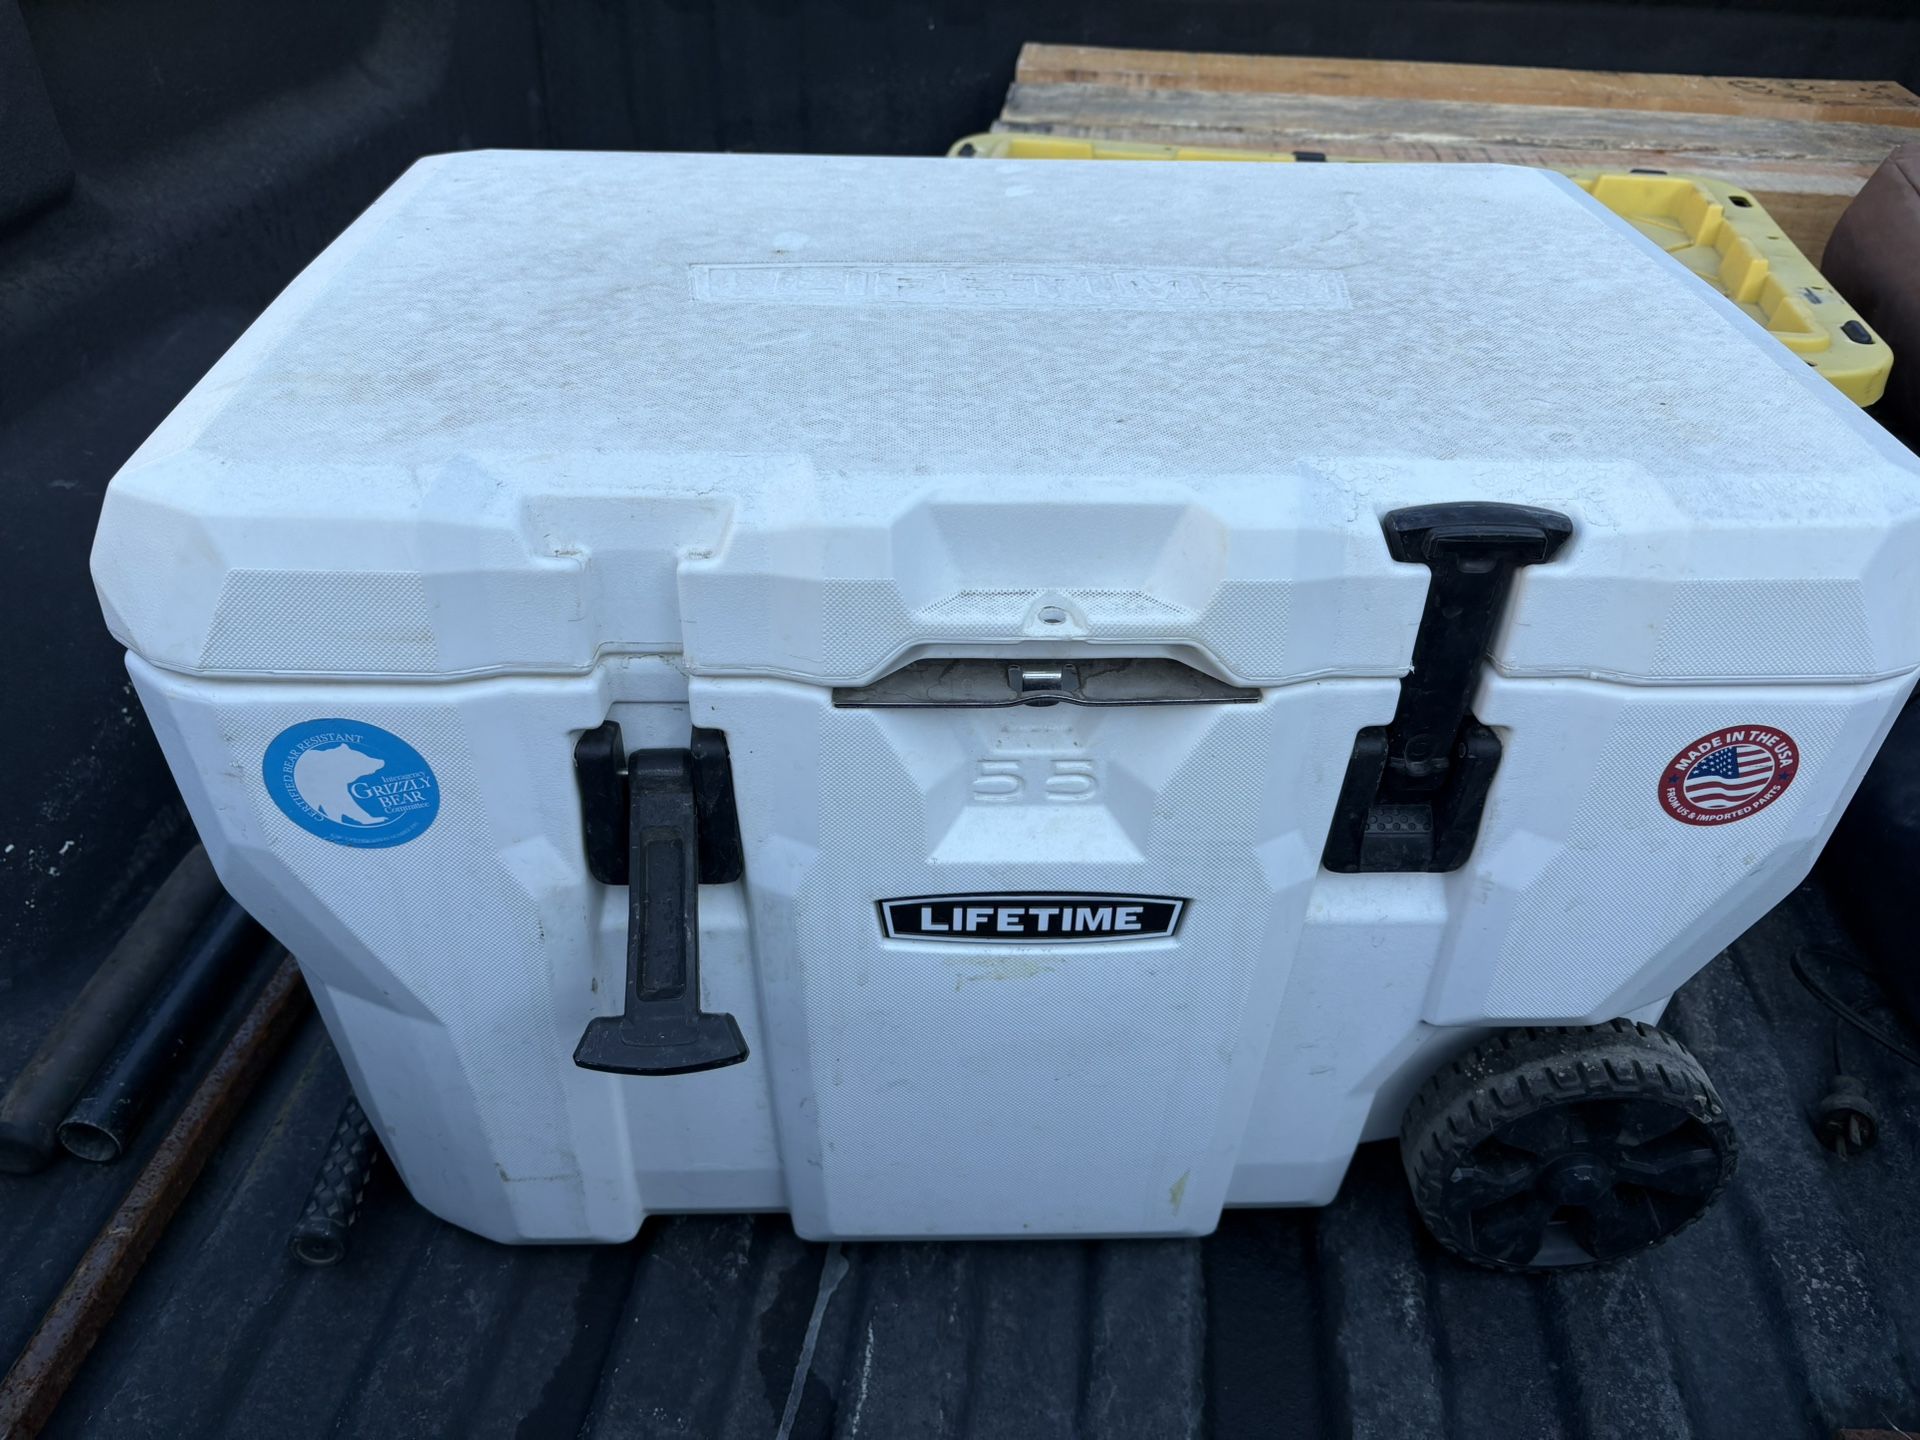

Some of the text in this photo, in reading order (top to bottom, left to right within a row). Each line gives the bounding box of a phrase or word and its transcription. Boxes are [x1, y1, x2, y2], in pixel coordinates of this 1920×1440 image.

[1675, 730, 1793, 771] MADE IN THE USA
[282, 732, 364, 822] CERTIFIED BEAR RESISTANT
[351, 776, 432, 799] GRIZZLY
[971, 759, 1099, 802] 55
[378, 790, 426, 808] BEAR
[384, 802, 432, 815] Committee
[1667, 784, 1782, 822] FROM US & IMPORTED PARTS
[921, 907, 1144, 932] LIFETIME
